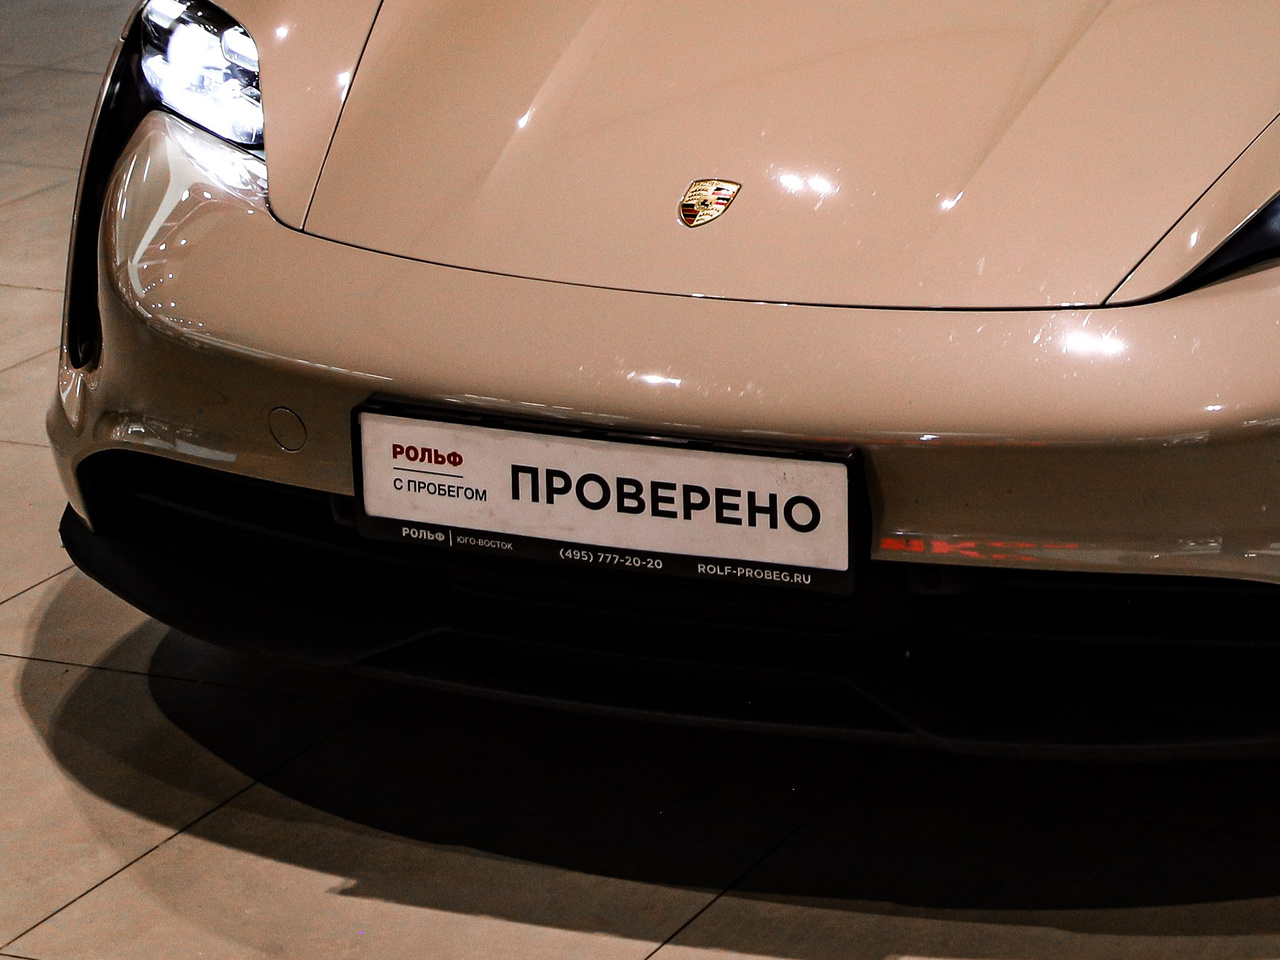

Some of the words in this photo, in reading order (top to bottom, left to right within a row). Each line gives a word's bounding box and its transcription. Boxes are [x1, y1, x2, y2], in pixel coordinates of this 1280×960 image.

[392, 443, 463, 467] РОЛЬФ
[393, 477, 404, 491] С
[407, 479, 487, 502] ПРОБЕГОМ
[511, 464, 821, 533] ПРОВЕРЕНО
[402, 526, 445, 542] РОЛЬФ
[456, 535, 514, 551] ЮГО-ВОСТОК
[559, 548, 593, 563] (495)
[597, 552, 663, 570] 777-20-20
[697, 563, 811, 585] ROLF-PROBEG.RU
